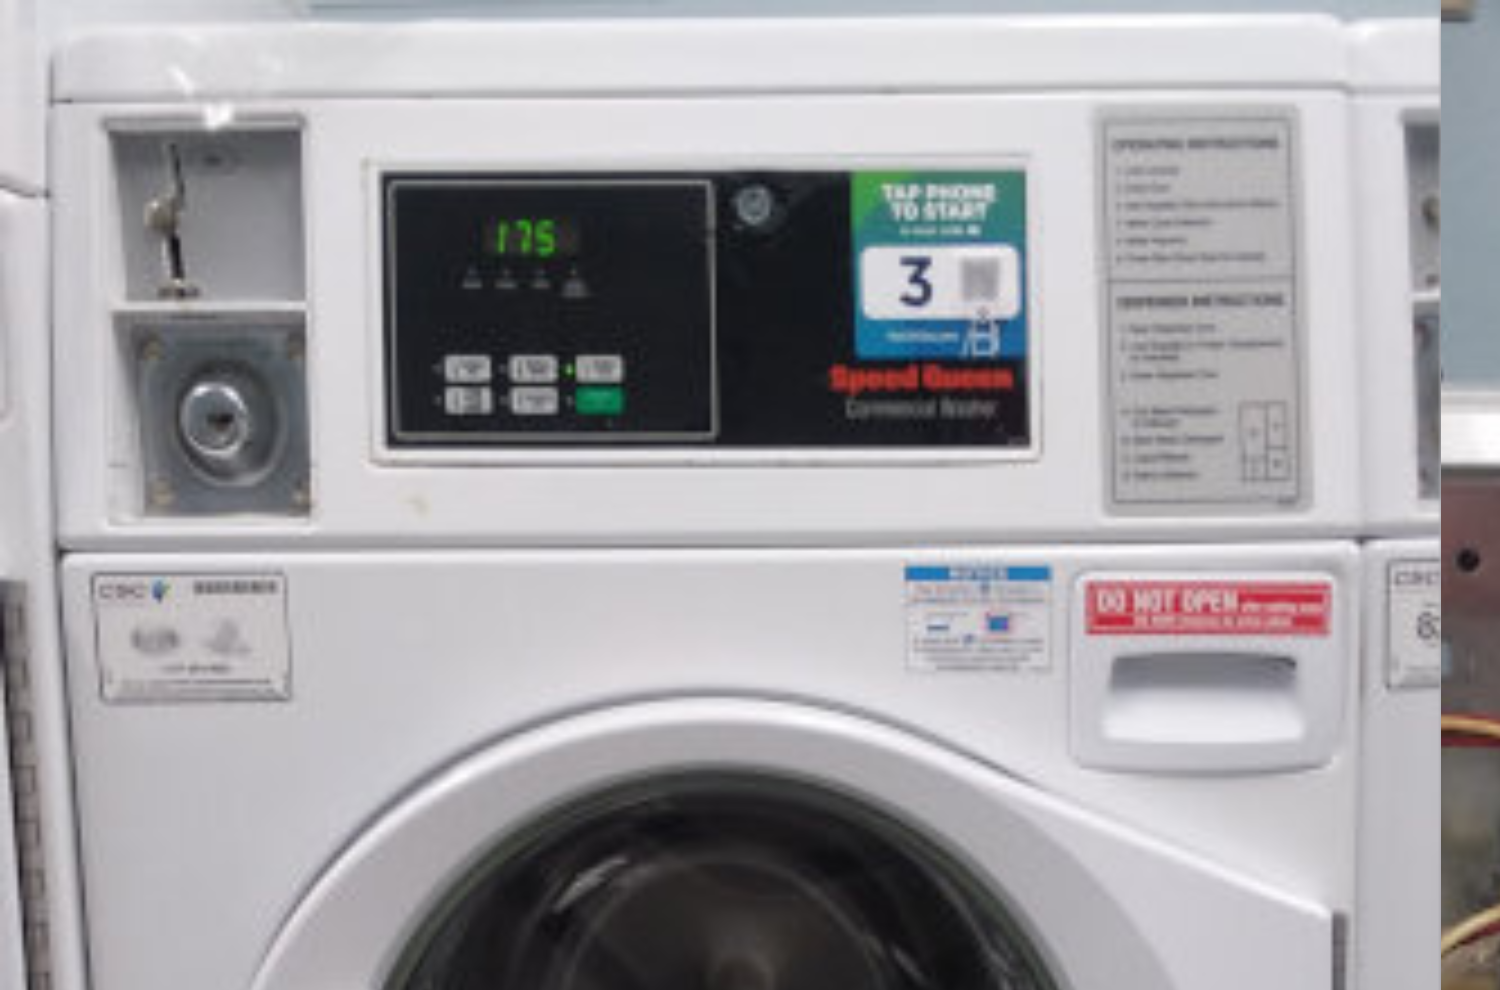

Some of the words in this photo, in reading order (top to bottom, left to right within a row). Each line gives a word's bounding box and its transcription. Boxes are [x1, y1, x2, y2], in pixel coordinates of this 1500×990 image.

[882, 184, 922, 200] TAP
[926, 184, 996, 202] PHONE
[891, 201, 919, 221] TO
[923, 200, 989, 221] START
[497, 219, 556, 256] 175
[899, 256, 933, 306] 3
[829, 364, 919, 395] Speed
[921, 363, 1013, 391] Queen
[1097, 588, 1126, 613] DO
[1133, 588, 1175, 613] NOT
[1183, 588, 1239, 613] OPEN
